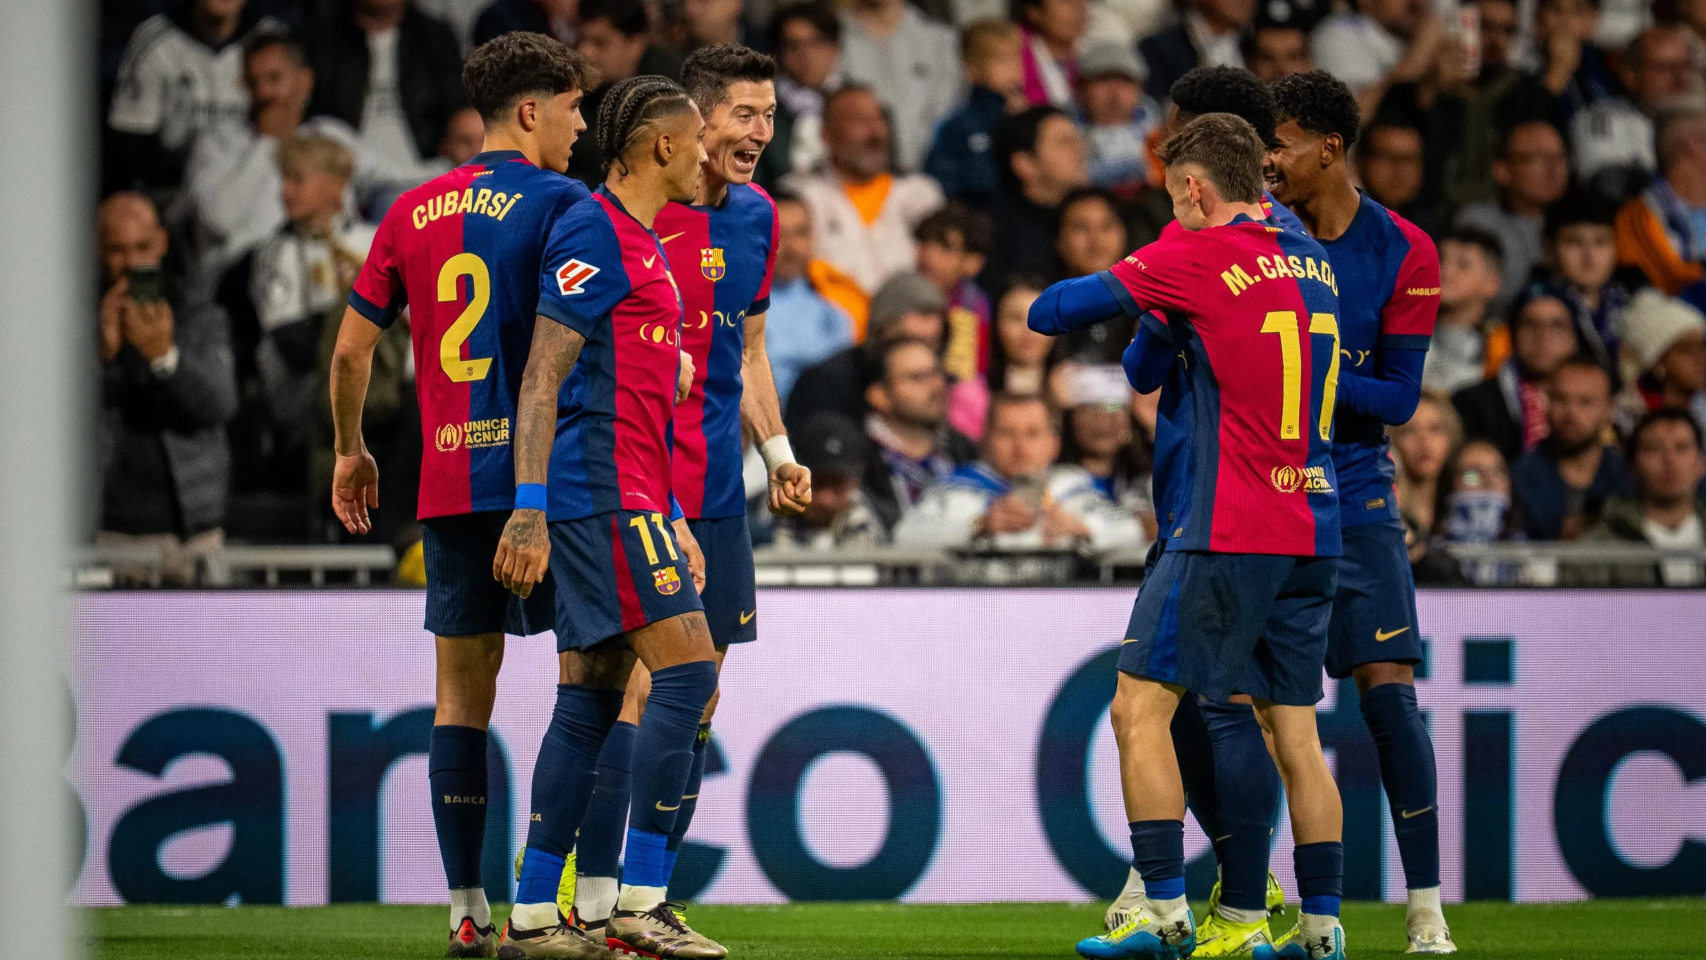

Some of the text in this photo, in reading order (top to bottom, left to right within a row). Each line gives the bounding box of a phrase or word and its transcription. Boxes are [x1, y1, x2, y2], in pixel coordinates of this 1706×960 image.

[412, 188, 523, 230] CUBARSÍ
[1220, 263, 1262, 297] M.
[437, 252, 493, 383] 2
[1260, 310, 1341, 442] 17
[464, 418, 509, 432] UNHCR
[464, 429, 509, 444] ACNUR
[629, 512, 679, 566] 11
[62, 672, 943, 905] ano
